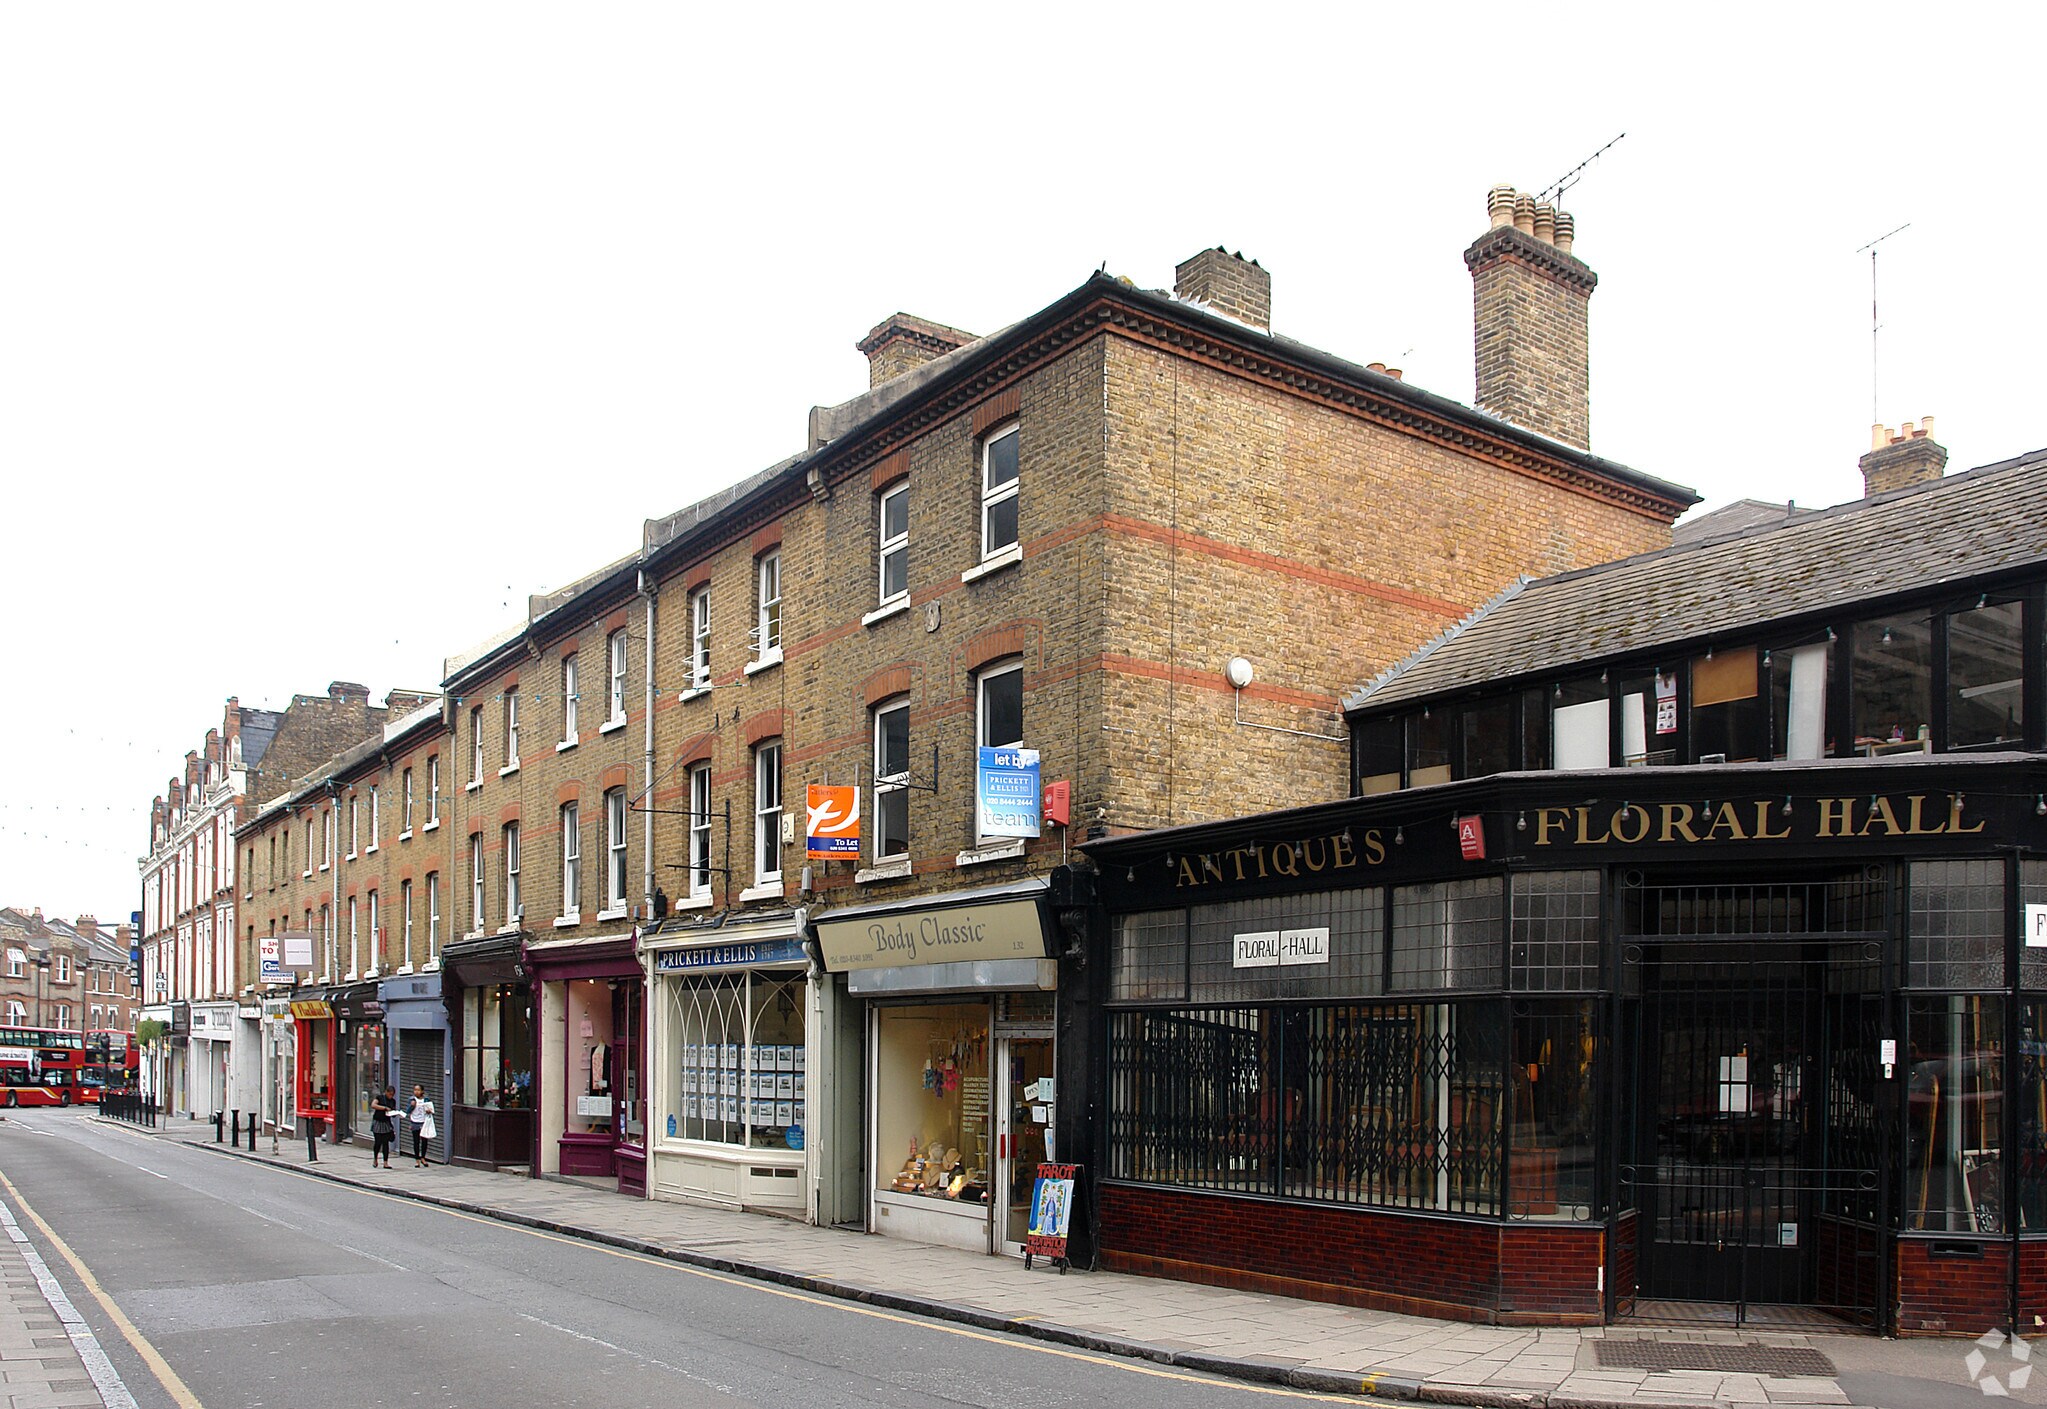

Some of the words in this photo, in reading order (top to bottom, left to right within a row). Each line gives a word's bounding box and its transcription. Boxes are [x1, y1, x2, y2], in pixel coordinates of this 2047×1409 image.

[994, 753, 1011, 766] let
[1012, 754, 1027, 769] by
[990, 776, 1029, 784] PRICKETT
[986, 796, 999, 805] 020
[1016, 798, 1034, 806] 2444
[984, 808, 1037, 827] team
[1534, 800, 1791, 846] FLORAL
[1816, 793, 1986, 838] HALL
[1176, 829, 1386, 888] ANTIQUES
[868, 921, 916, 960] Body
[920, 916, 984, 946] Classic
[261, 947, 274, 955] TO
[1012, 941, 1025, 951] 132
[1238, 937, 1278, 959] FLORAL
[1289, 935, 1323, 956] HALL
[663, 949, 713, 967] PRICKETT
[724, 945, 756, 963] ELLIS
[1026, 1086, 1038, 1096] OPEN
[1037, 1164, 1076, 1179] TAROT
[1027, 1236, 1067, 1249] MEDITATION
